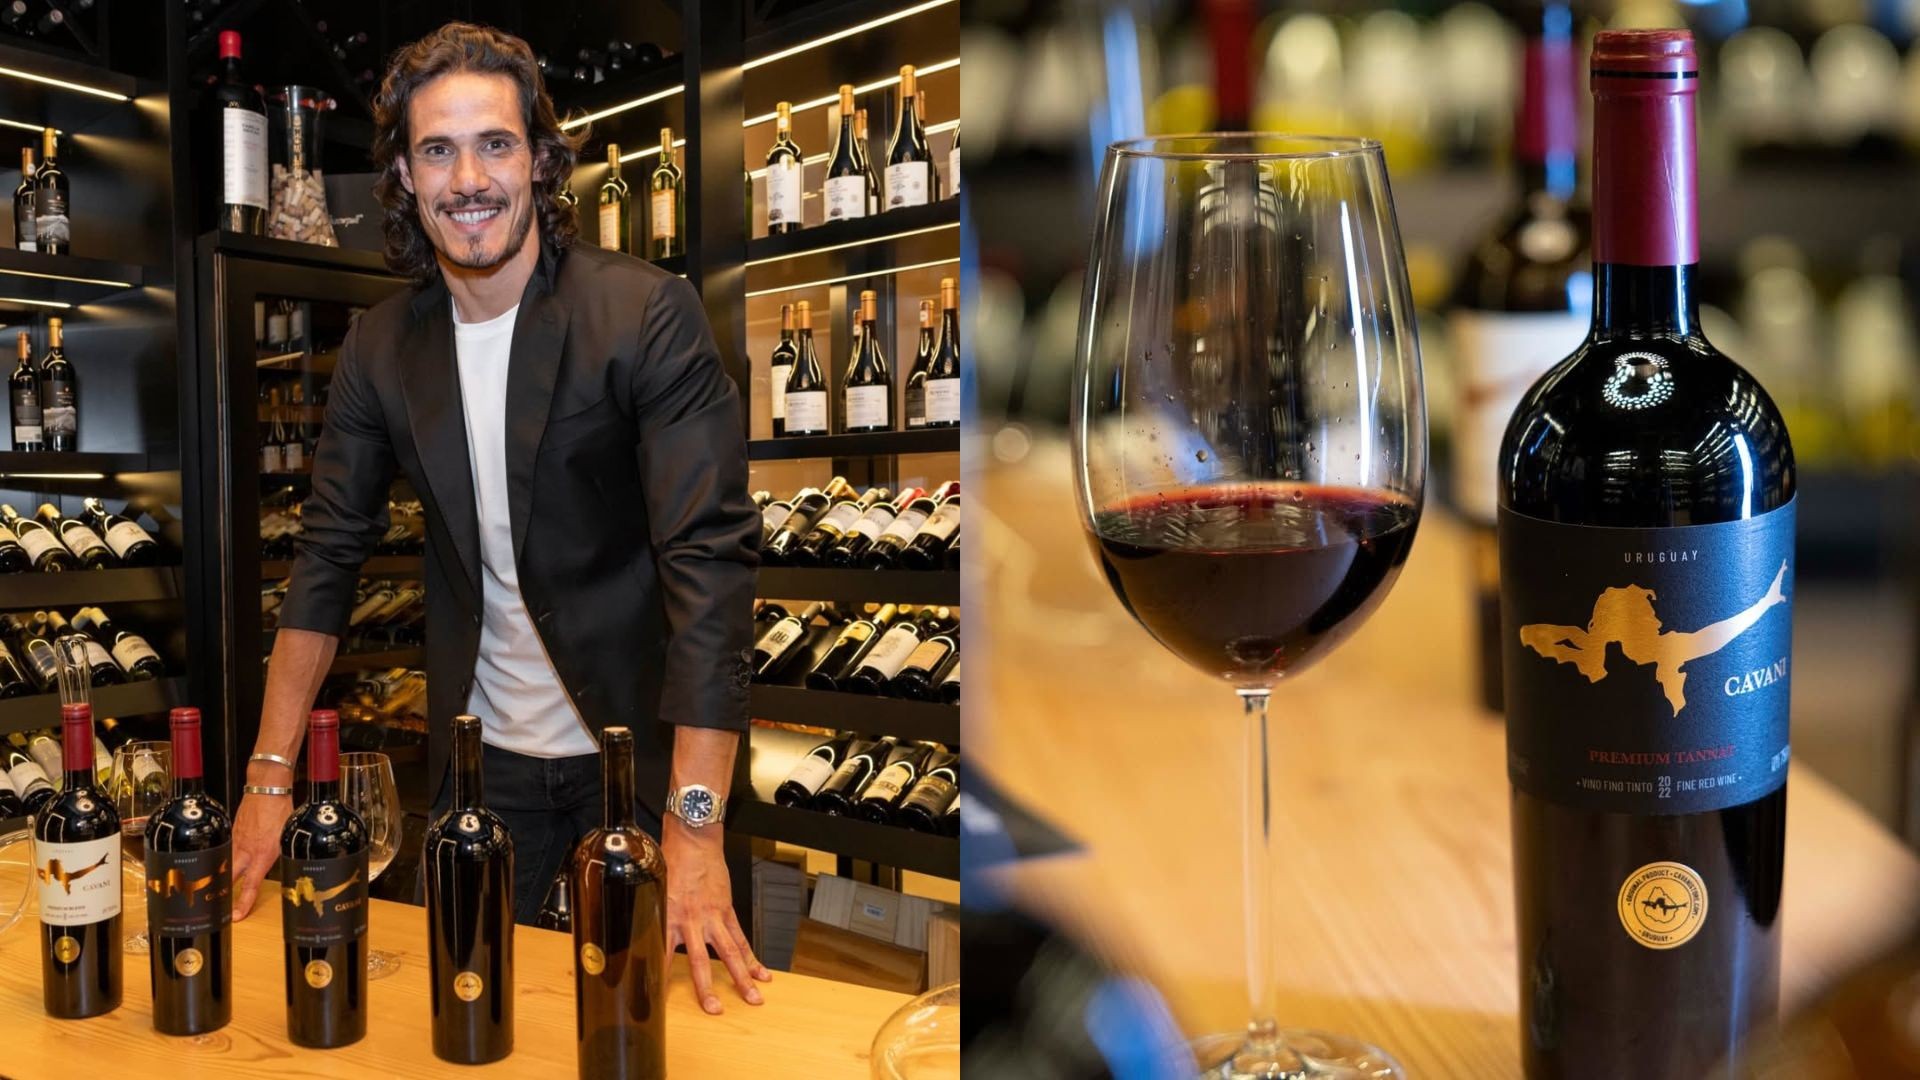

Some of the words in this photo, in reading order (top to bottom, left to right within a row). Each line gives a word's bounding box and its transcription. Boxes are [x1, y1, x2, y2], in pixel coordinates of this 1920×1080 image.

[1624, 550, 1698, 563] URUGUAY
[1724, 656, 1786, 696] CAVANI
[1589, 750, 1671, 765] PREMIUM
[1676, 744, 1735, 764] TANNAT
[1582, 777, 1601, 790] VINO
[1603, 780, 1624, 792] FINO
[1627, 782, 1653, 793] TINTO
[1658, 776, 1671, 787] 20
[1677, 779, 1697, 791] FINE
[1699, 777, 1715, 789] RED
[1717, 773, 1737, 786] WINE
[1658, 787, 1671, 798] 22
